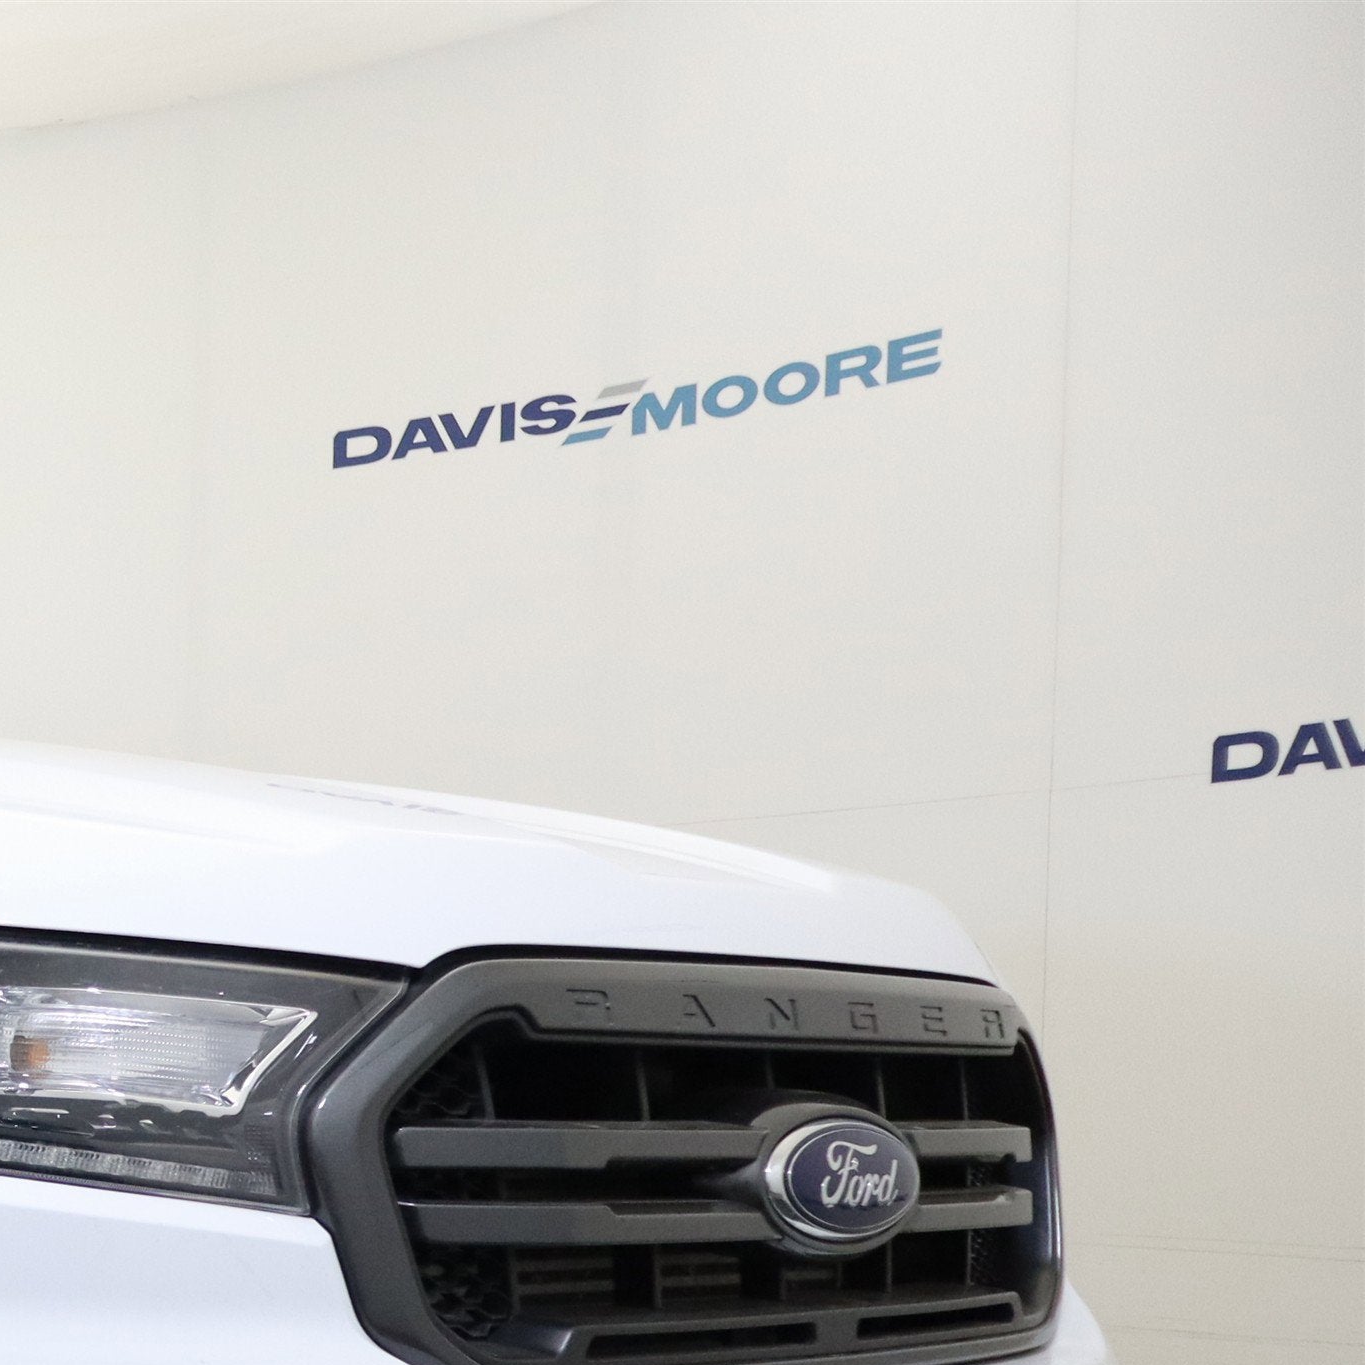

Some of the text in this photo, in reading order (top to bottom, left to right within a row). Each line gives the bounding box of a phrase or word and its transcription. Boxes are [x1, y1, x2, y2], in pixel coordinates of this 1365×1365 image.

[333, 328, 943, 469] DAVIS MOORE
[565, 988, 1006, 1040] RANGER
[820, 1140, 899, 1209] Ford
